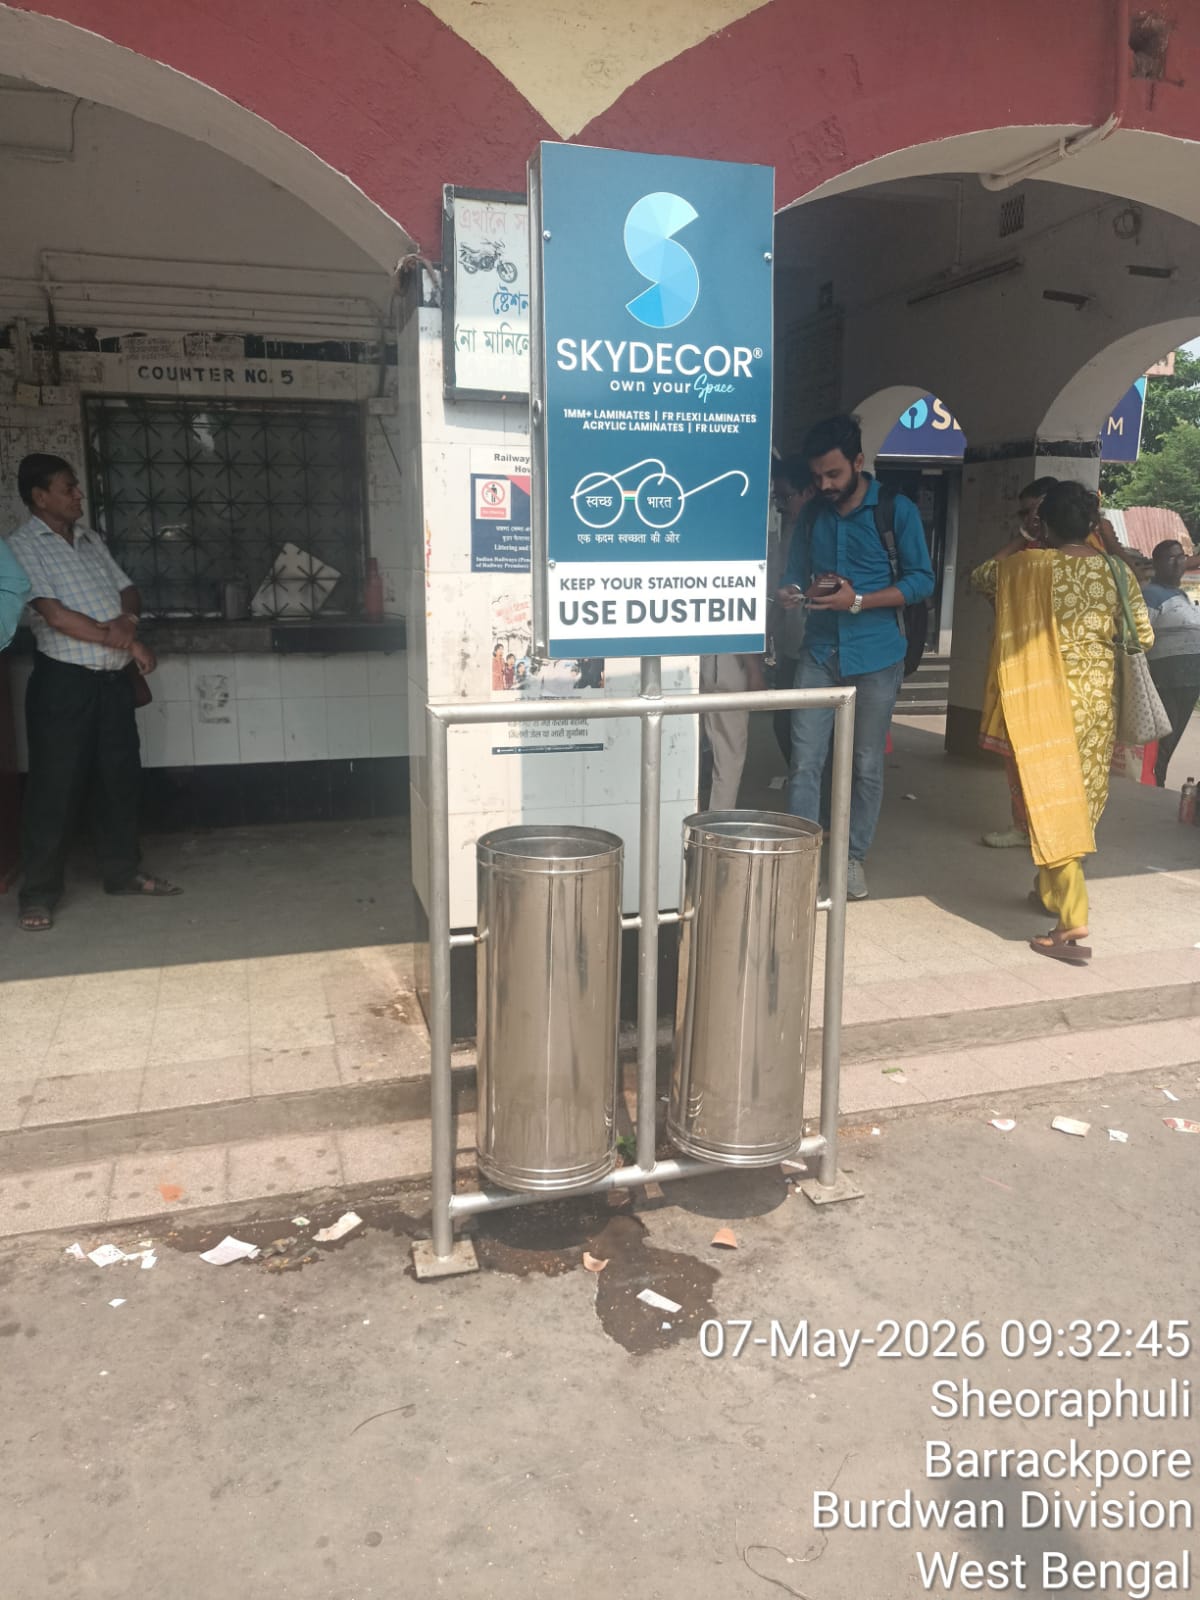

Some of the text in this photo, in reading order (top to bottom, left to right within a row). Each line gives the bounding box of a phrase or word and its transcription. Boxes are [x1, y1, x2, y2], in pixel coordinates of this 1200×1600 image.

[138, 366, 294, 385] COUNTER NO. 5
[610, 373, 735, 403] own your Space
[563, 409, 592, 419] 1MM+
[594, 409, 650, 420] LAMINATES
[662, 411, 674, 421] FR
[676, 411, 700, 422] FLEXI
[703, 413, 757, 424] LAMINATES
[583, 421, 626, 431] ACRYLIC
[629, 422, 684, 433] LAMINATES
[695, 424, 707, 433] FR
[709, 424, 739, 434] LUVEX
[585, 495, 672, 509] स्वच्छ भारत
[577, 531, 680, 545] एक कदम स्वच्छता की ओर
[560, 575, 756, 591] KEEP YOUR STATION CLEAN
[559, 600, 617, 626] USE
[626, 598, 757, 624] DUSTBIN
